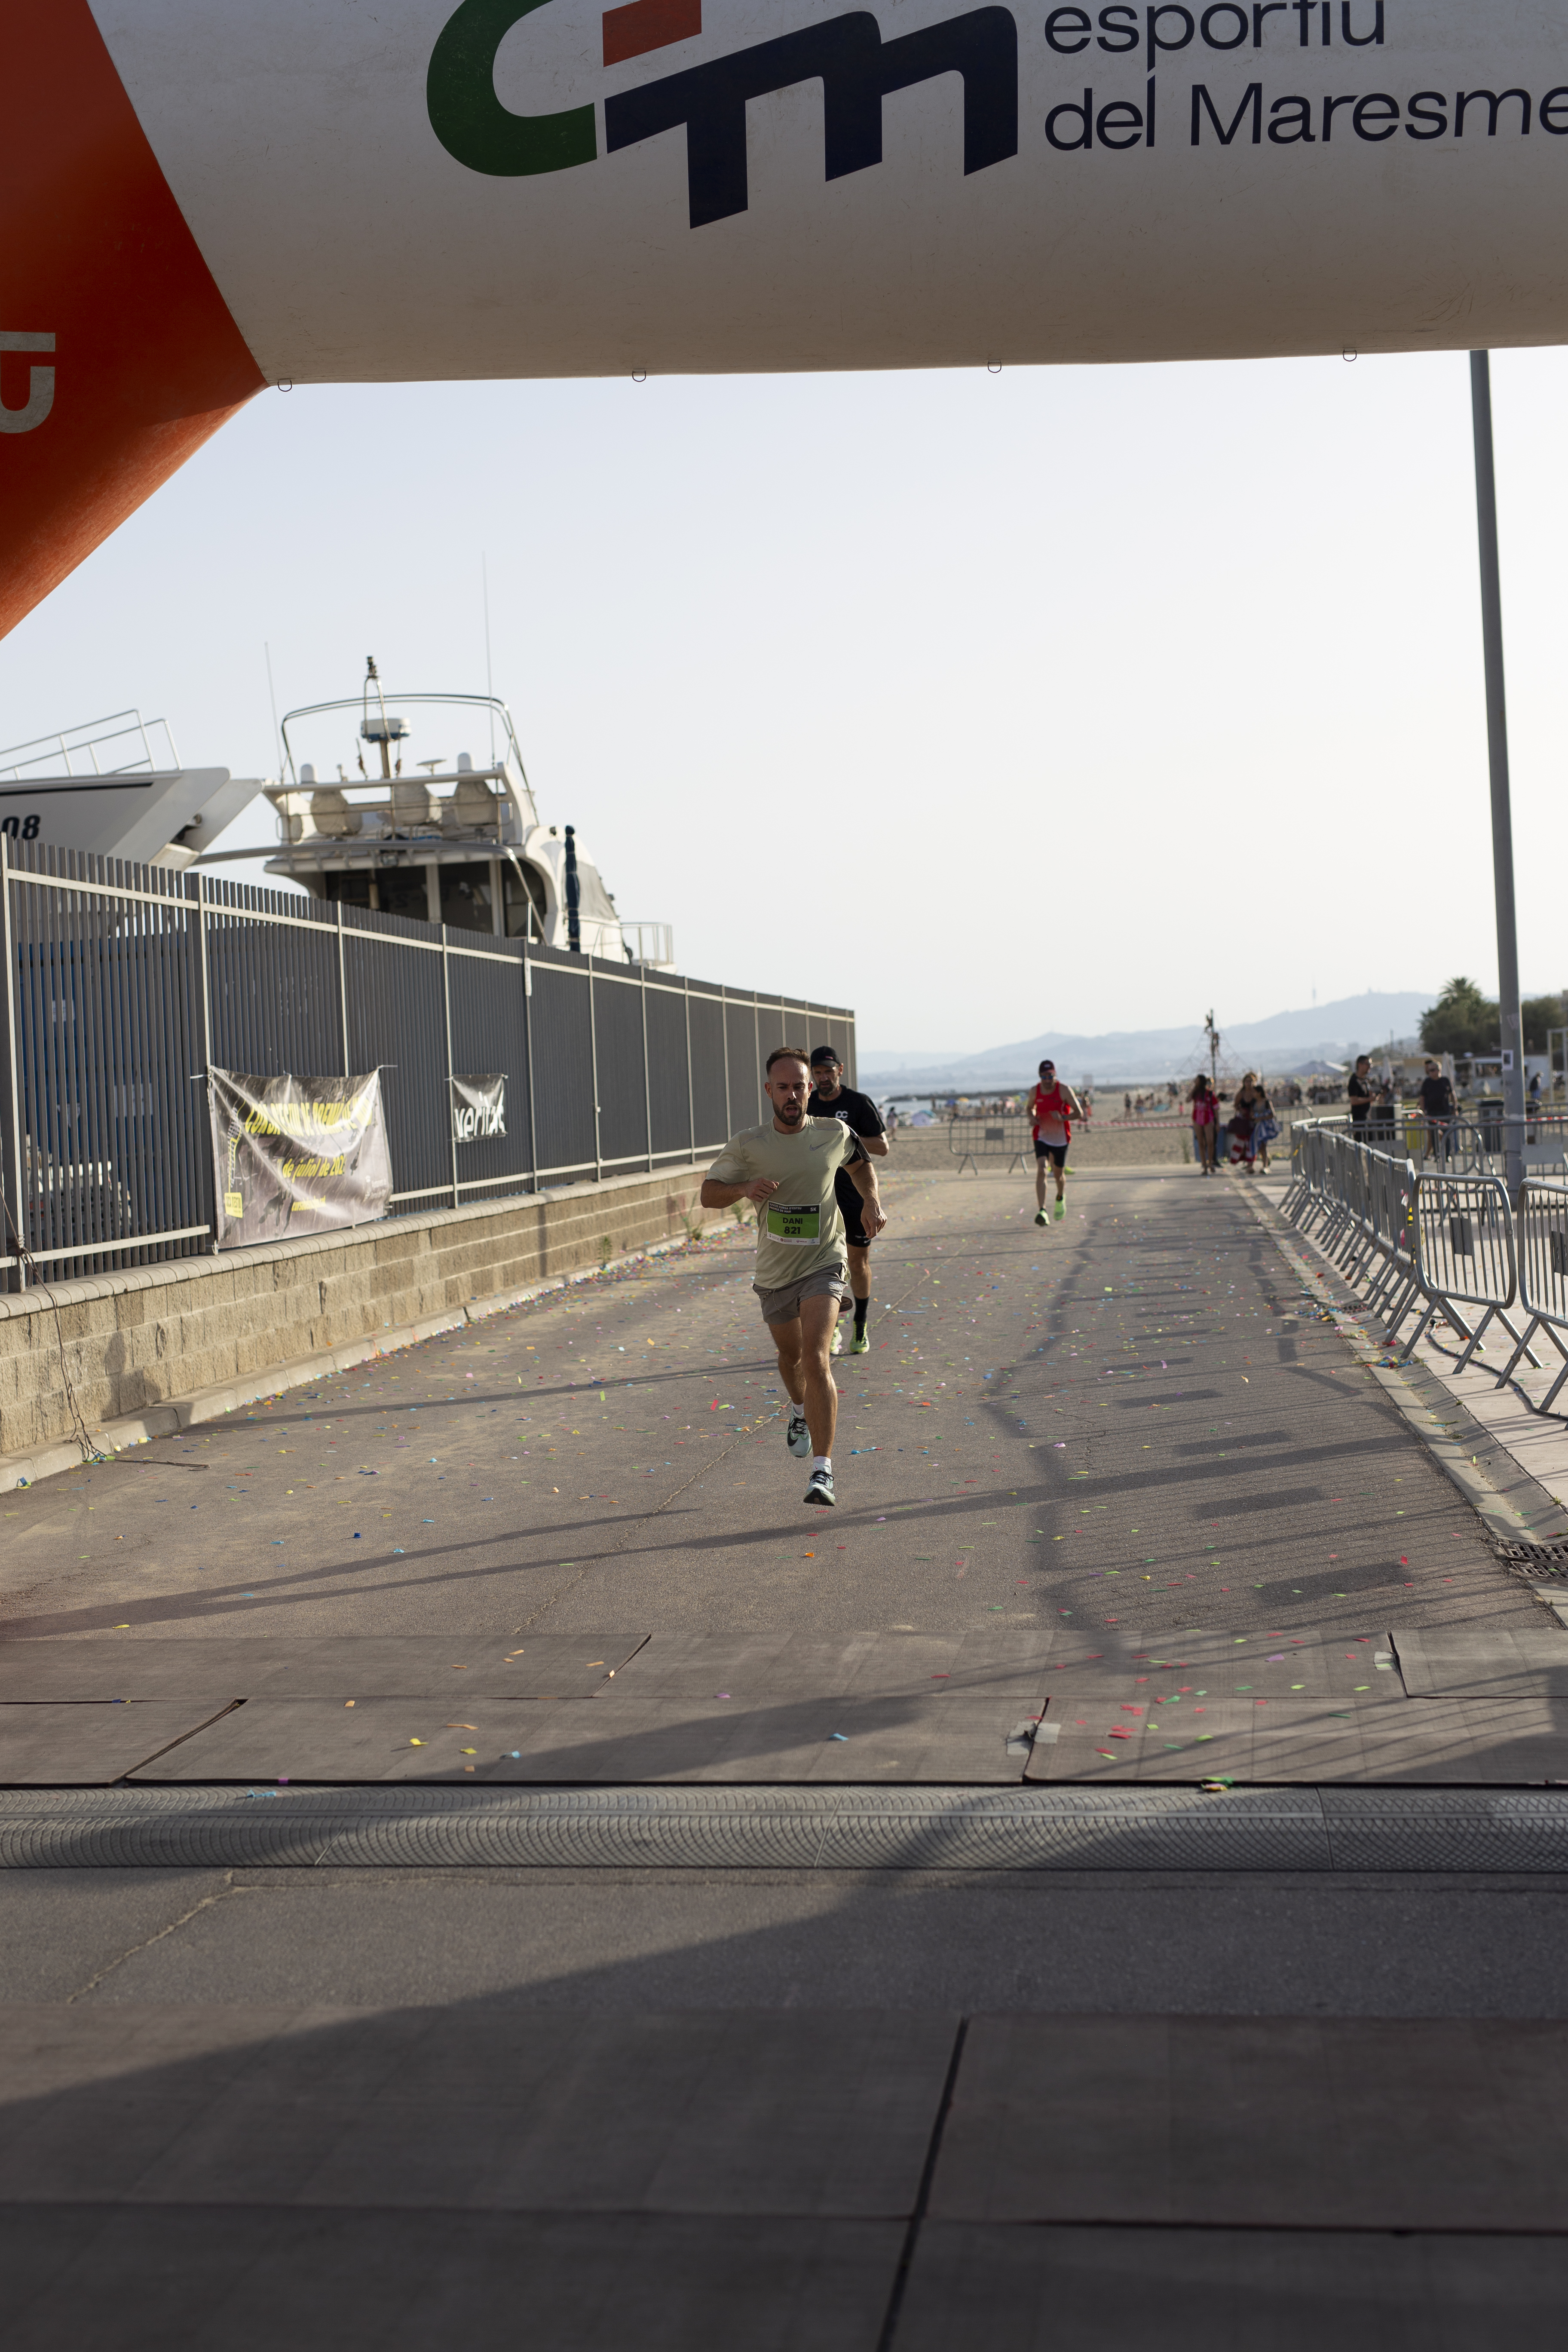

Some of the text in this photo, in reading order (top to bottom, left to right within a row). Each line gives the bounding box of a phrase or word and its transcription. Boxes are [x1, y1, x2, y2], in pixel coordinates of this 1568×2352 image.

[1044, 0, 1384, 73] esportiu
[1044, 74, 1568, 150] del Maresme
[282, 1158, 294, 1178] de
[318, 1157, 330, 1177] de
[784, 1226, 801, 1234] 821
